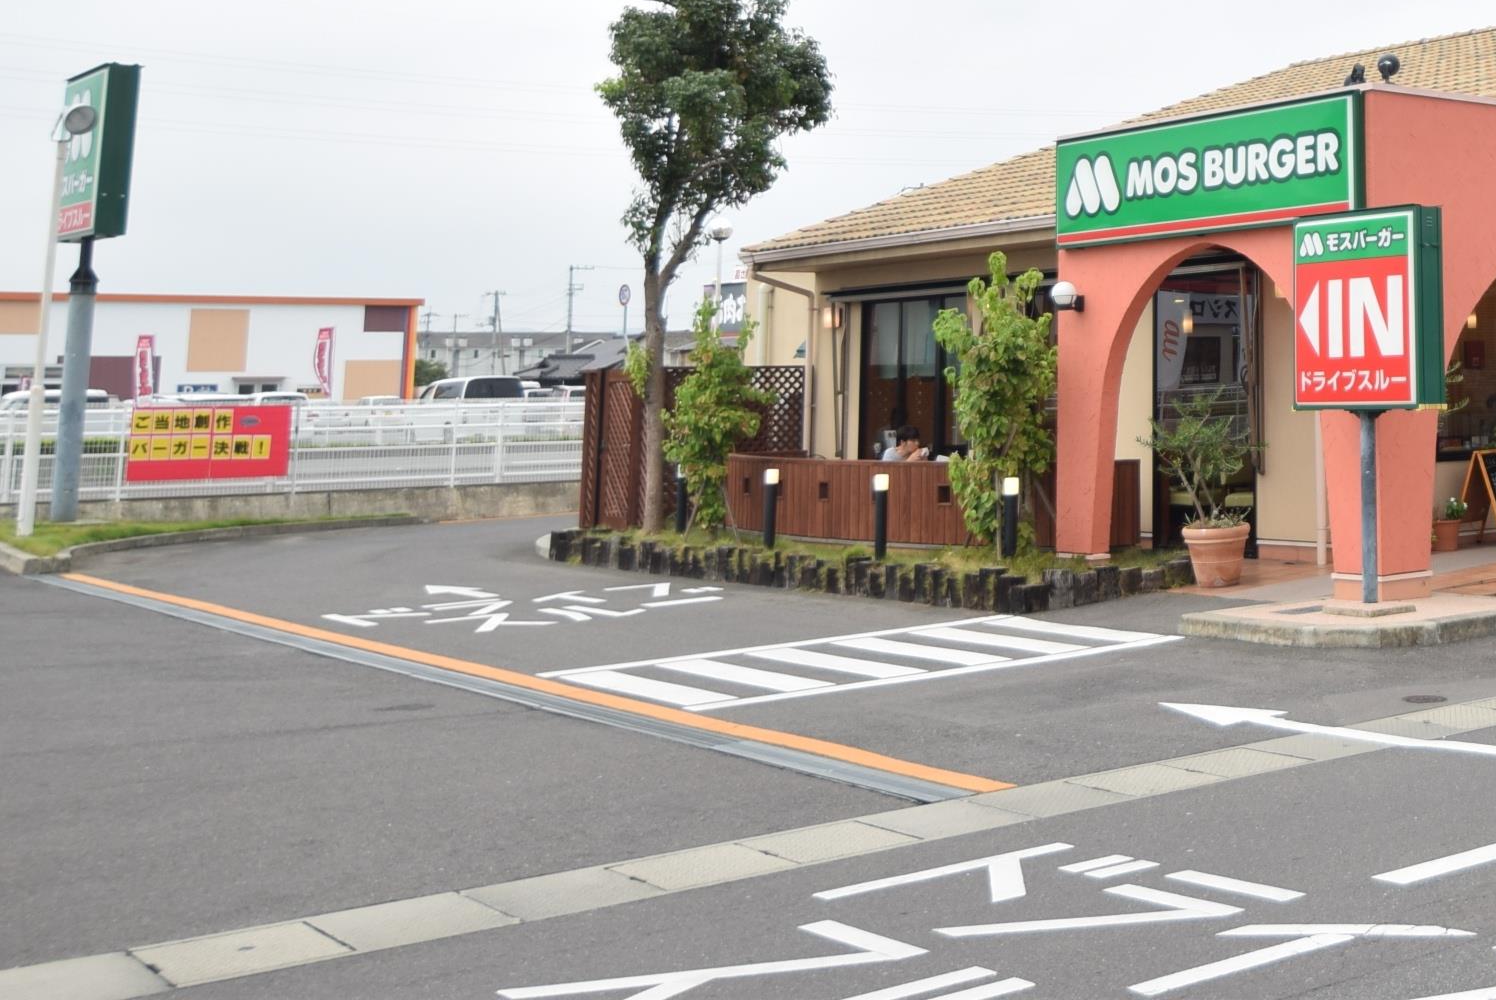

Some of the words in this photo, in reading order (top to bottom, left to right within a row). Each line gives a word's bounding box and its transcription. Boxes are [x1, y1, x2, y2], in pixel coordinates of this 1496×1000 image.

[1126, 151, 1198, 199] MOS
[1203, 131, 1340, 190] BURGER
[1326, 228, 1405, 253] モスバーガー
[1327, 274, 1405, 359] IN
[1300, 368, 1407, 392] ドライブスルー
[135, 413, 231, 430] ご当地創作
